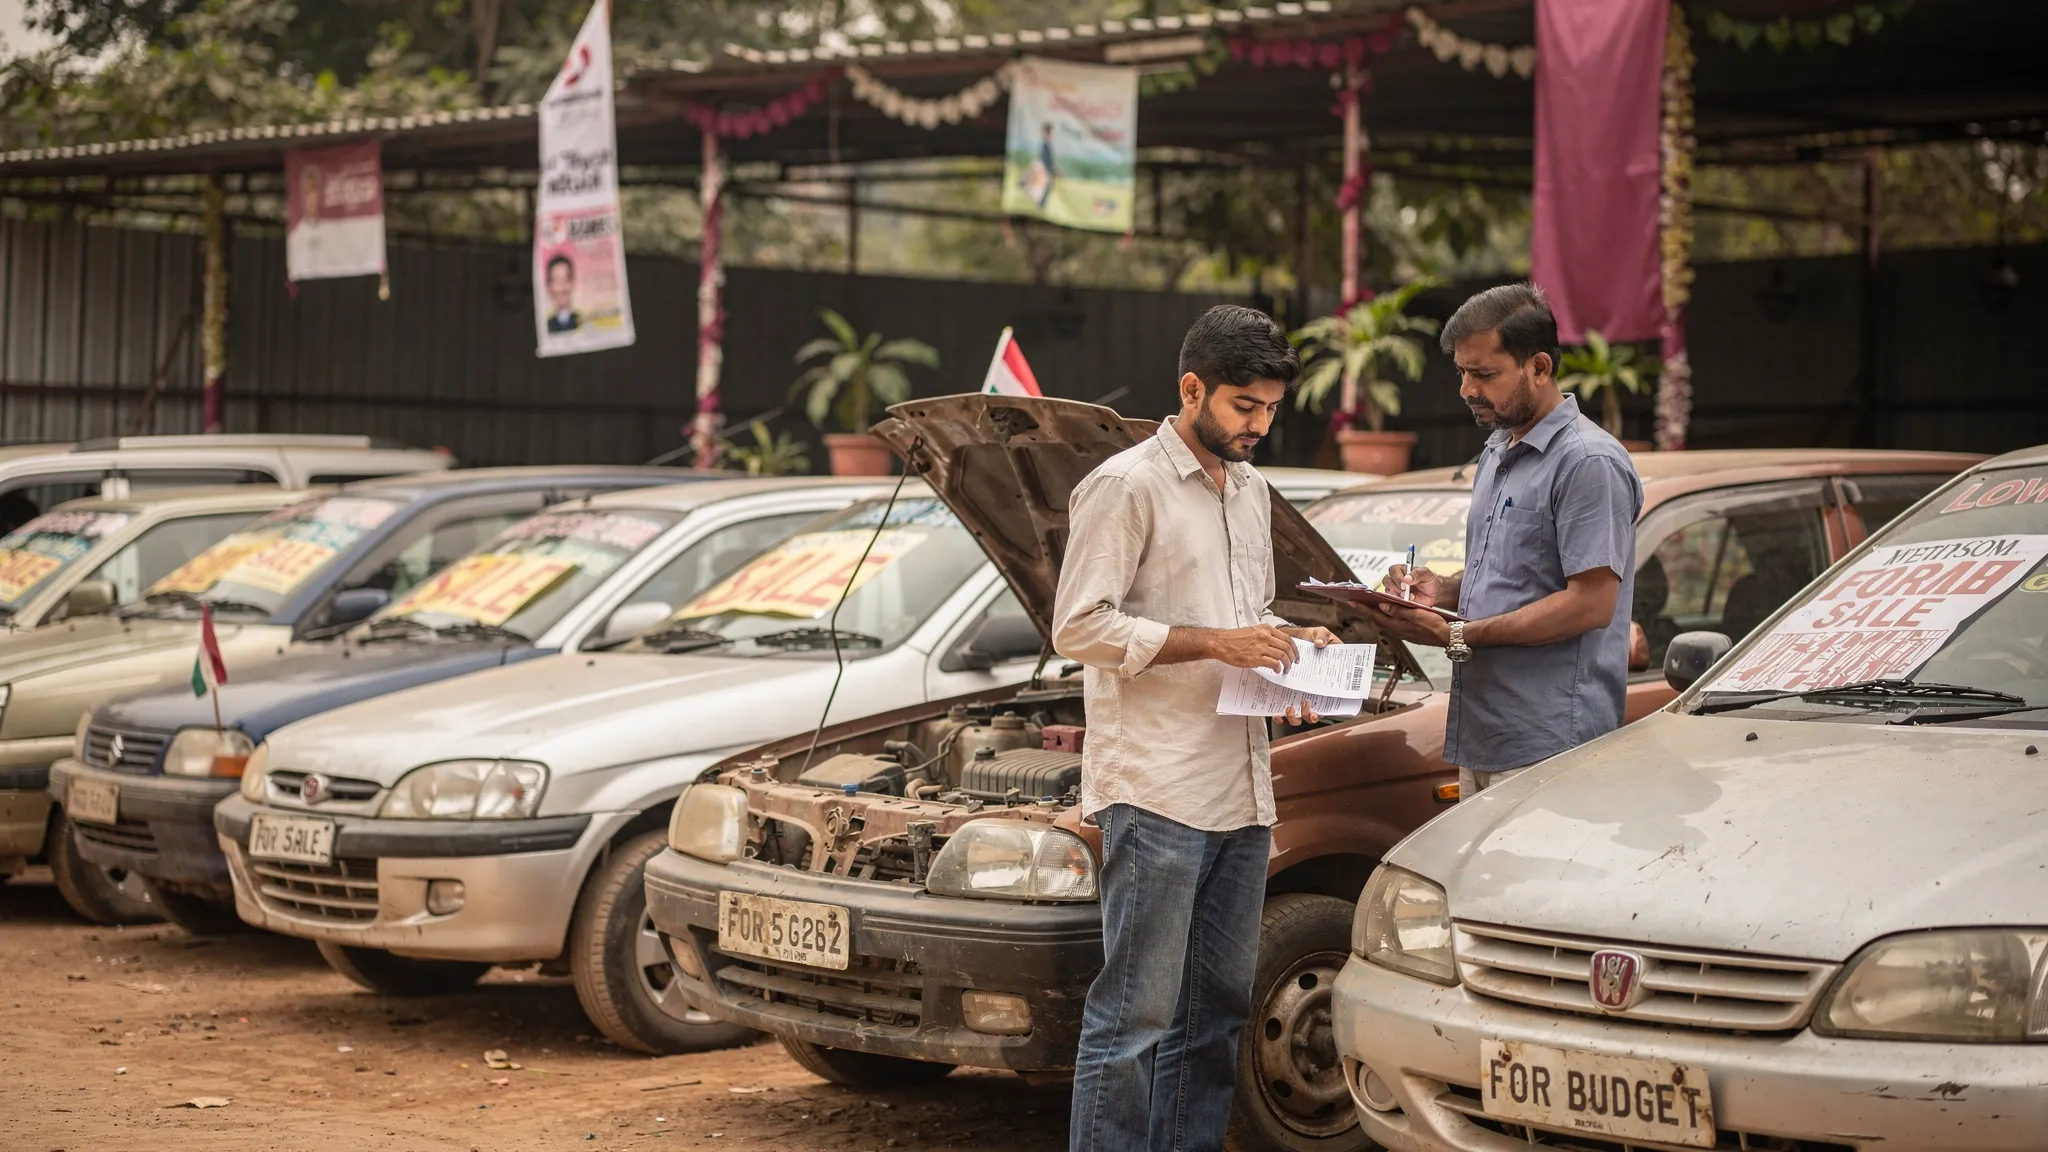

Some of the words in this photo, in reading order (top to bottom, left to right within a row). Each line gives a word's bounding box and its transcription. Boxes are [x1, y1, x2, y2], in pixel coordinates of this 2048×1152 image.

[696, 552, 890, 608] SALE
[1812, 597, 1946, 629] SALE
[283, 826, 320, 856] SALE
[728, 907, 764, 944] FOR
[1490, 1058, 1551, 1107] FOR
[1567, 1070, 1701, 1129] BUDGET
